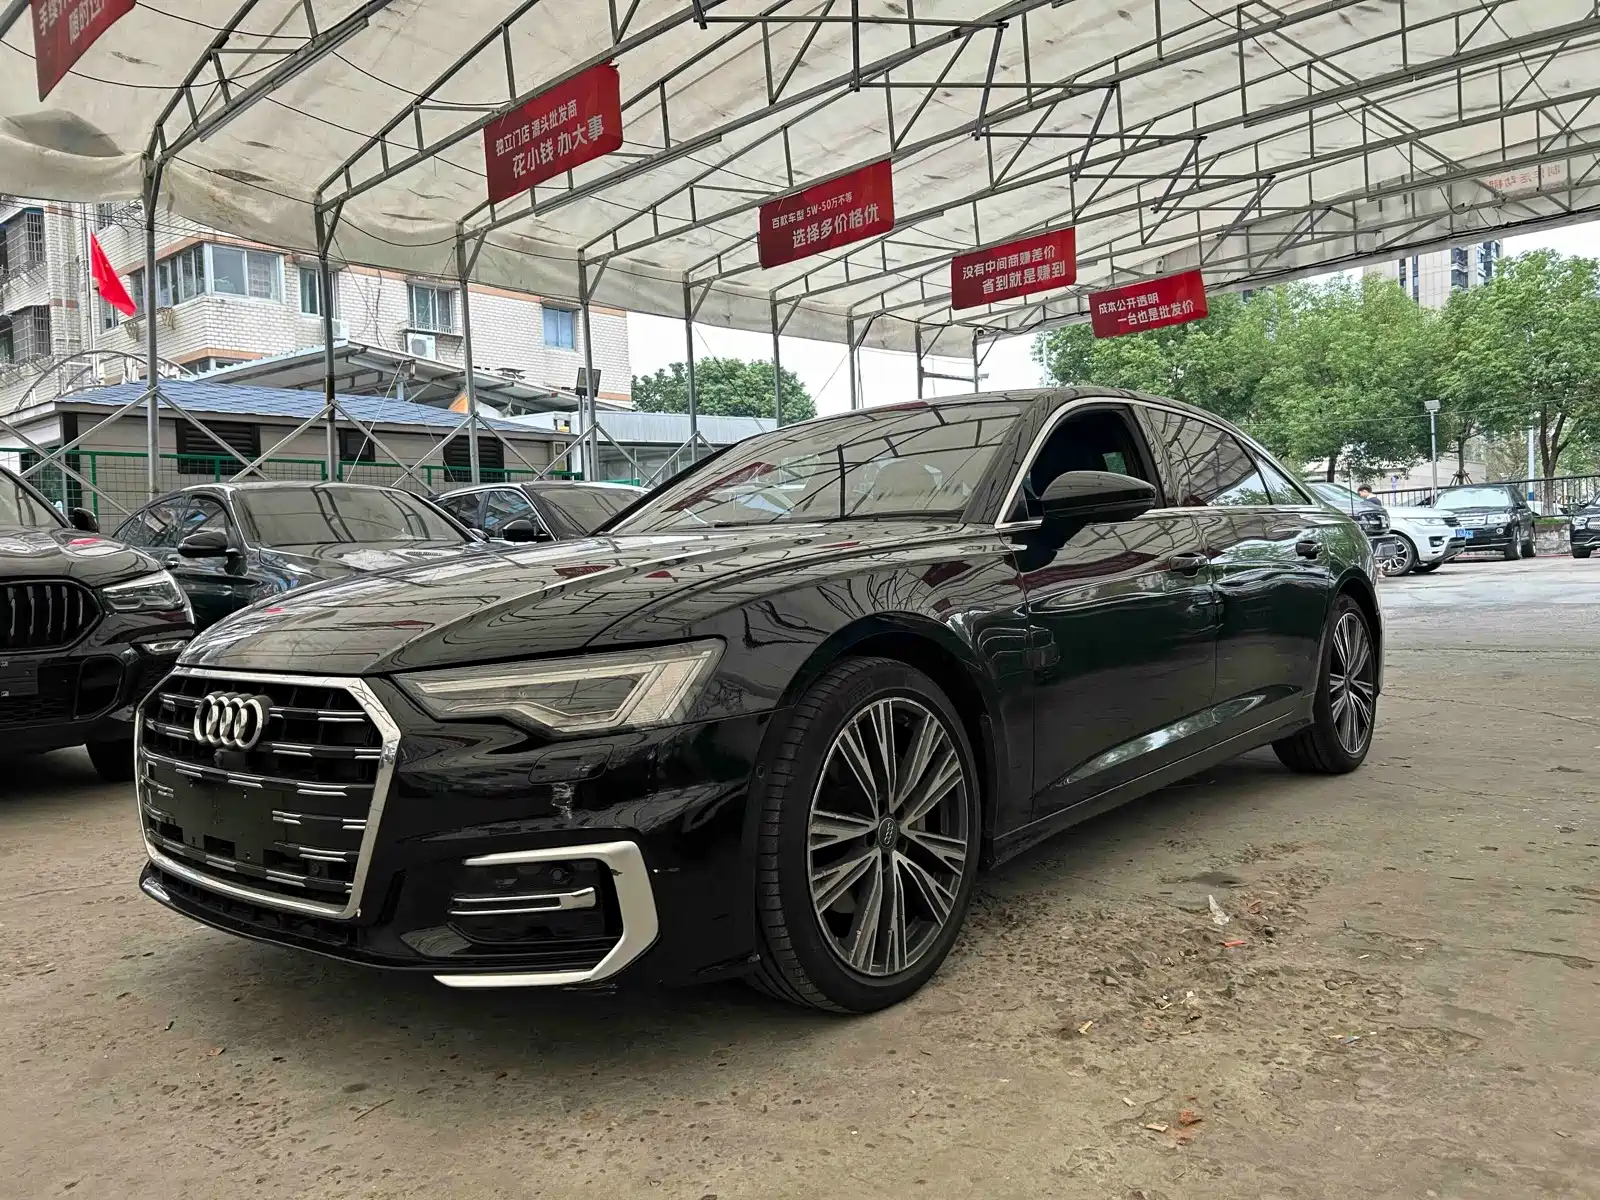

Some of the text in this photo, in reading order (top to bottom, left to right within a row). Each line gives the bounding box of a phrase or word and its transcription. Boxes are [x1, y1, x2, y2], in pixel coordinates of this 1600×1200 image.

[495, 99, 578, 157] 独立门店 源头批发商
[512, 114, 604, 178] 花小钱 办大事
[771, 191, 853, 229] 百款车型 5W-50万不等
[792, 203, 879, 248] 选择多价格优
[962, 244, 1055, 279] 没有中间商赚差价
[982, 260, 1066, 294] 省到就是赚到
[1098, 292, 1159, 315] 成本公开透明
[1117, 299, 1194, 325] 一台也是批发价
